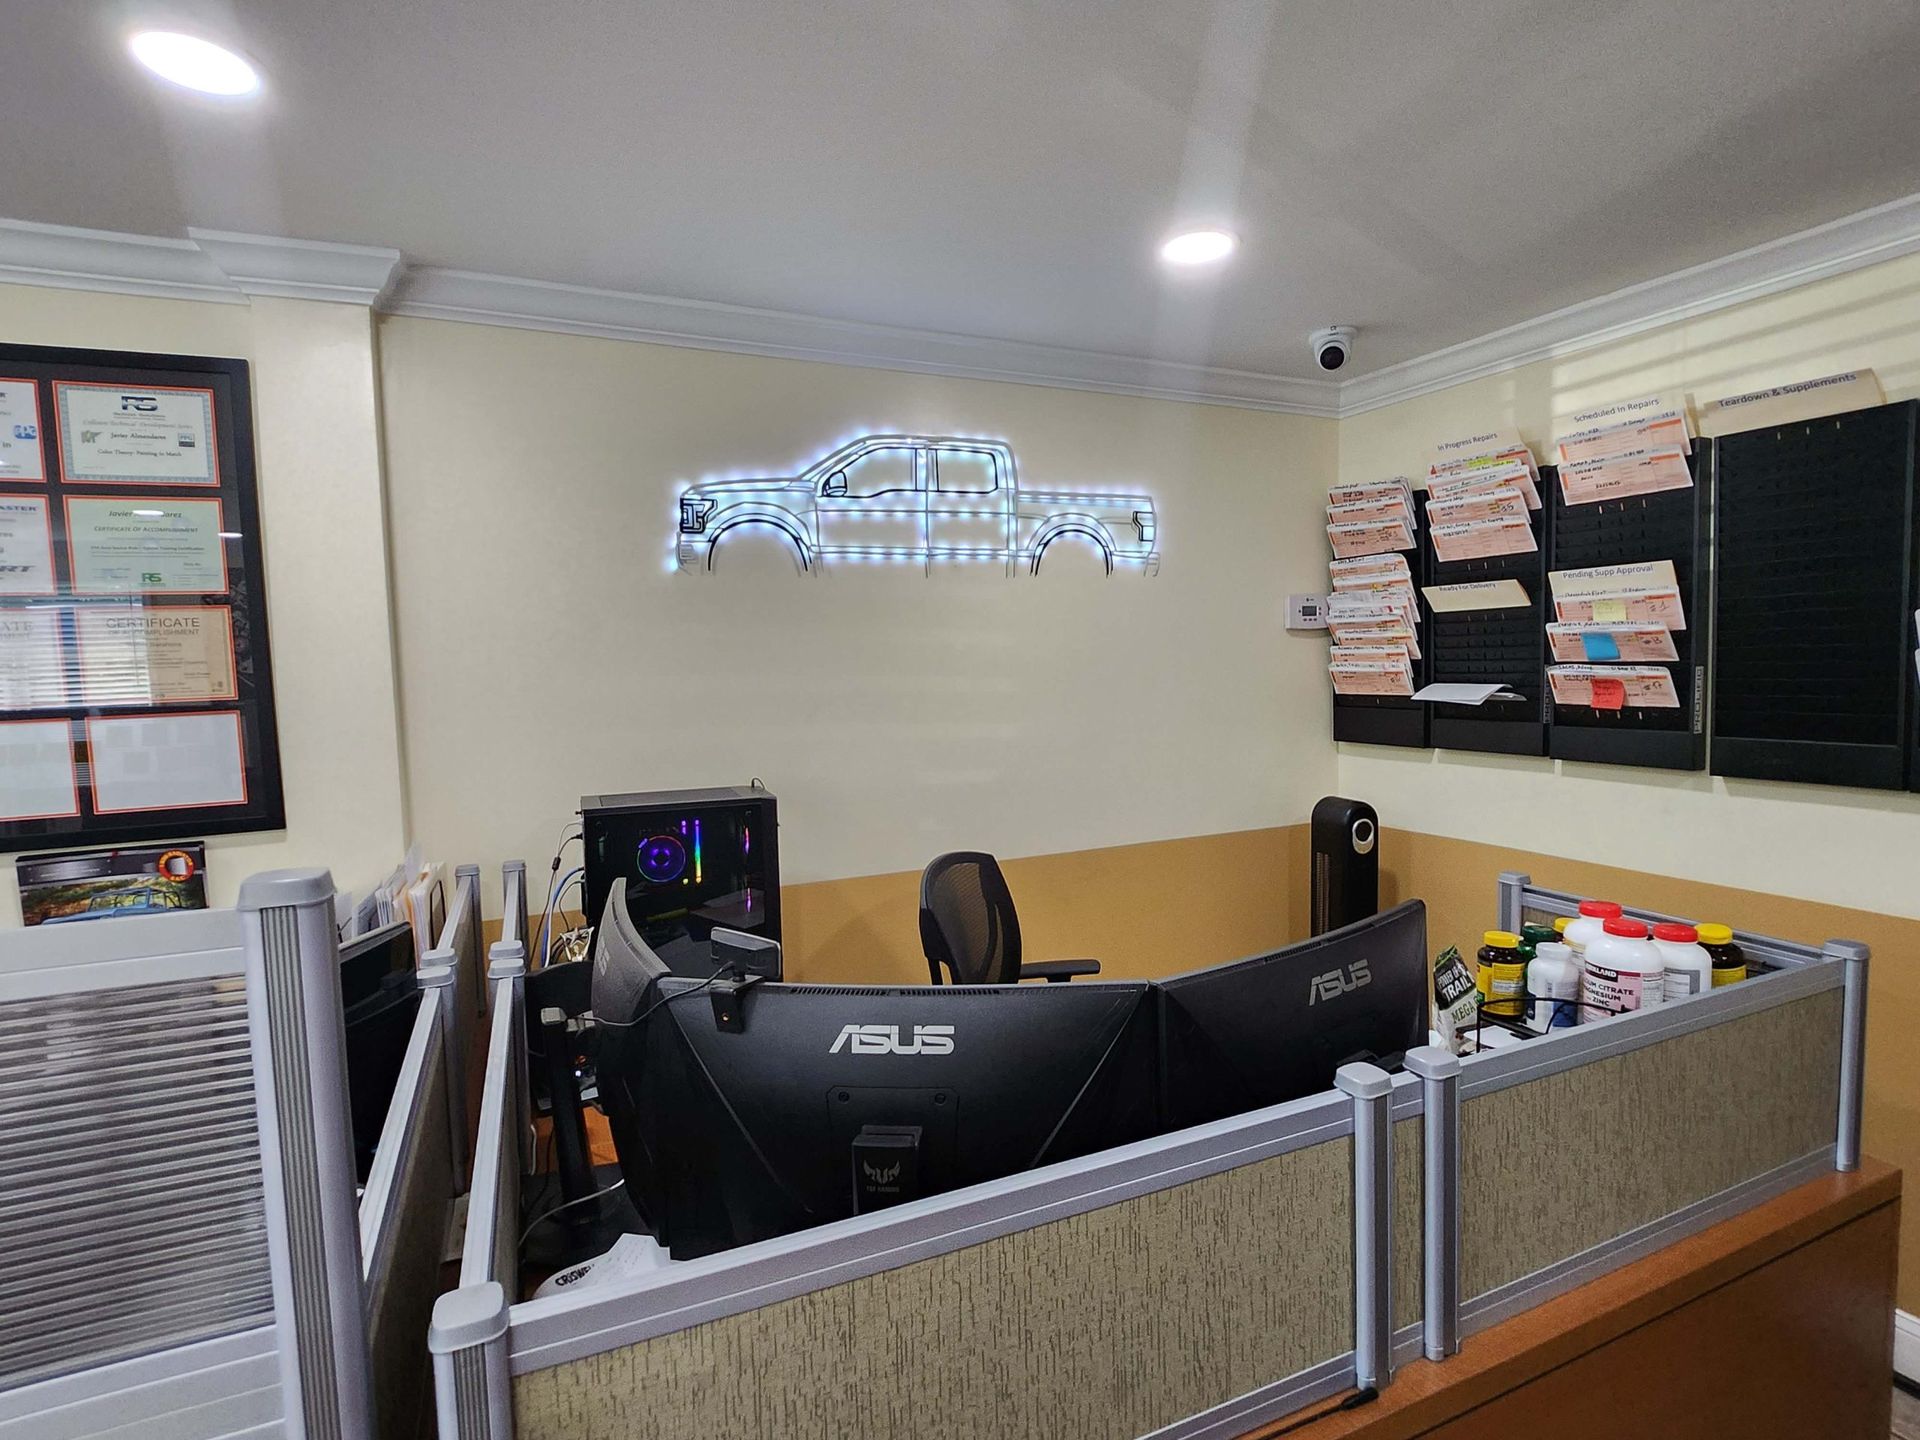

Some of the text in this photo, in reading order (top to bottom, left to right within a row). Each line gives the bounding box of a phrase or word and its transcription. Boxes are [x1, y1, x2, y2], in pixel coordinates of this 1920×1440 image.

[1718, 373, 1857, 408] Teardown & Supplements
[1573, 398, 1660, 423] Scheduled In Repairs
[1437, 432, 1498, 451] In Progress Repairs
[1562, 564, 1654, 579] Pending Supp Approval
[106, 617, 200, 629] CERTIFICATE
[1309, 959, 1372, 1006] ASUS
[1442, 976, 1471, 1002] TRAIL
[1598, 984, 1635, 996] CITRATE
[1585, 986, 1622, 1002] AGNESIUM
[1592, 996, 1610, 1007] ZINC
[1451, 1000, 1476, 1024] MEGA
[829, 1024, 955, 1055] ASUS
